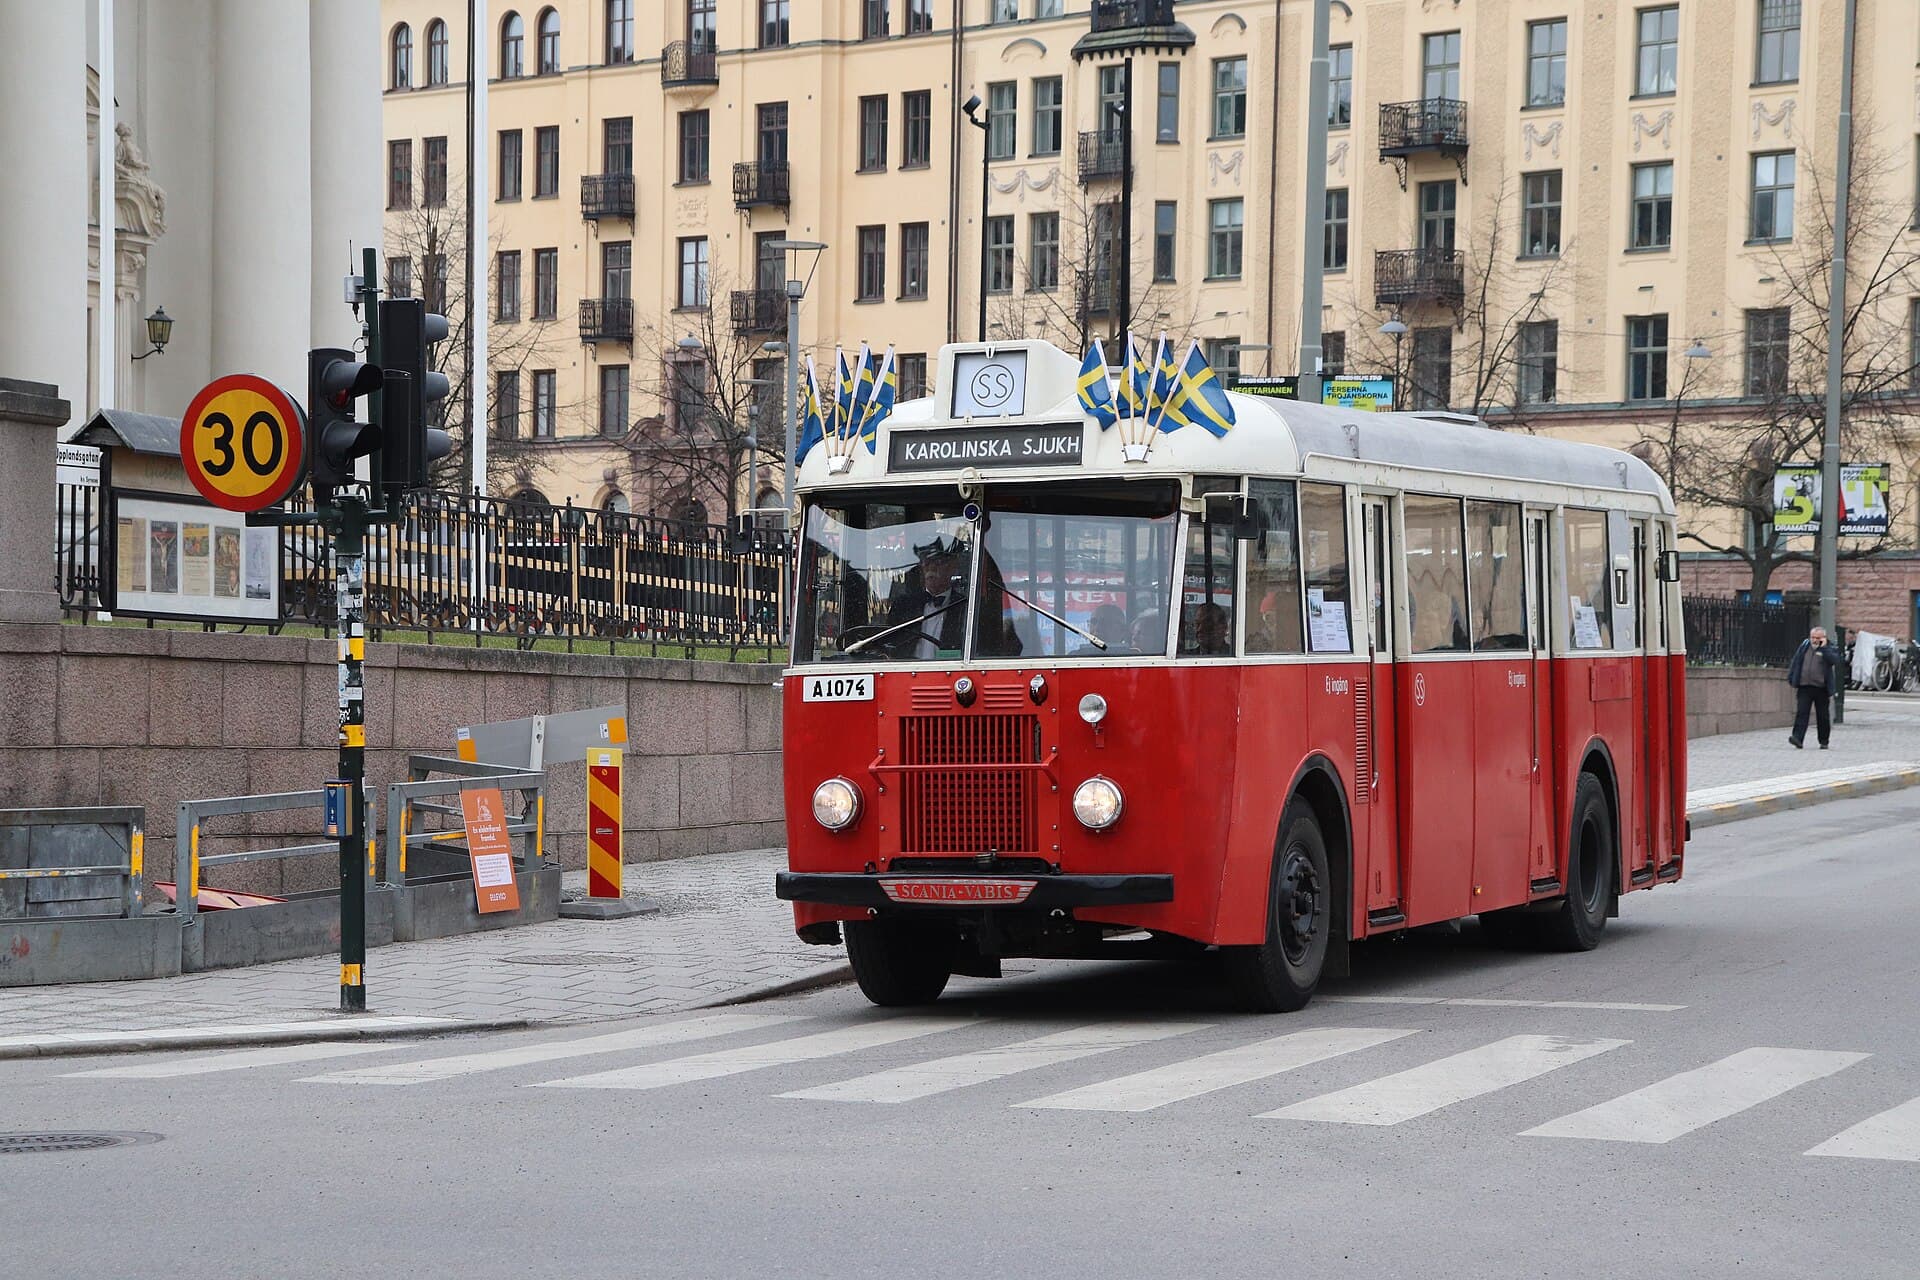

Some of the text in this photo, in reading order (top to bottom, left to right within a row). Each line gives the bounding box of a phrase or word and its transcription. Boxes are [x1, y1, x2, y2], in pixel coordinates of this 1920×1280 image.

[977, 373, 1008, 399] SS
[1231, 386, 1293, 394] VEGETARIANEN
[202, 411, 283, 476] 30
[905, 439, 1012, 460] KAROLINSKA
[1840, 525, 1886, 533] DRAMATEN
[1325, 675, 1348, 695] Ej ingång
[902, 884, 1013, 899] SCANIA-VABIS
